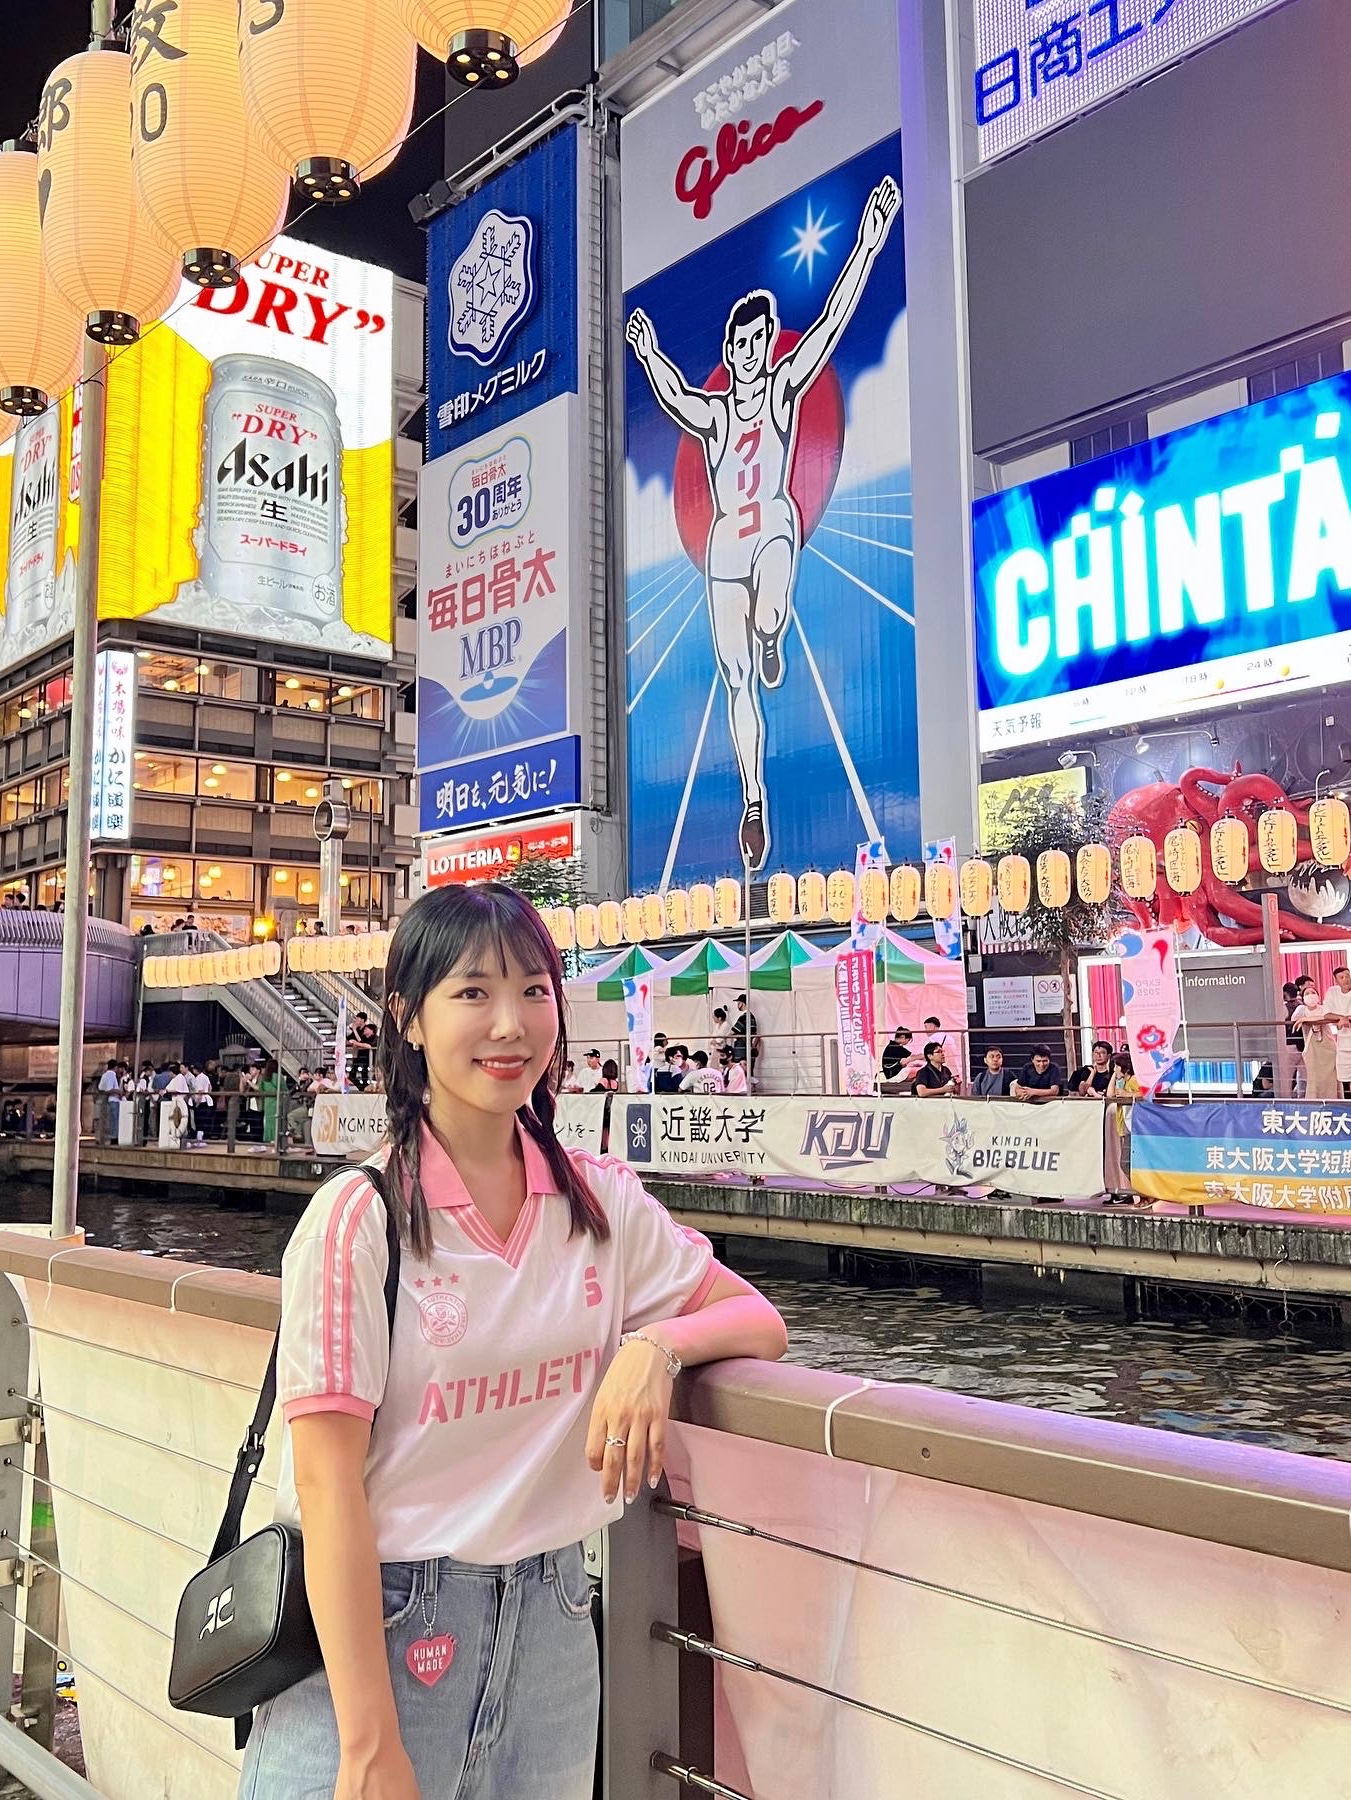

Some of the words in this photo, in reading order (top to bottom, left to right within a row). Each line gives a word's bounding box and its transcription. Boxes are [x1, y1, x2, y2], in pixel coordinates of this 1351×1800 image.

[675, 99, 824, 219] Glico
[254, 251, 330, 289] UPER
[437, 349, 546, 430] 雪印メグミルク
[255, 403, 297, 422] SUPER
[217, 437, 328, 507] Asahi
[734, 419, 763, 539] グリコ
[13, 456, 56, 530] Asahi
[260, 499, 288, 523] 生
[492, 499, 522, 520] ありがとう
[240, 534, 307, 557] スーパードライ
[427, 547, 556, 632] 毎日骨太
[460, 617, 523, 680] MBP
[992, 712, 1042, 738] 天気予報
[430, 847, 503, 875] LOTTERIA
[1185, 975, 1246, 987] information
[660, 1106, 766, 1143] 近畿大学
[1261, 1110, 1351, 1136] 東大阪大
[992, 1135, 1039, 1148] KINDAI
[661, 1151, 697, 1164] KINDAI
[973, 1149, 1001, 1168] BIG
[1005, 1151, 1061, 1172] BLUE
[413, 1643, 447, 1661] HUMAN
[417, 1658, 443, 1674] MADE
